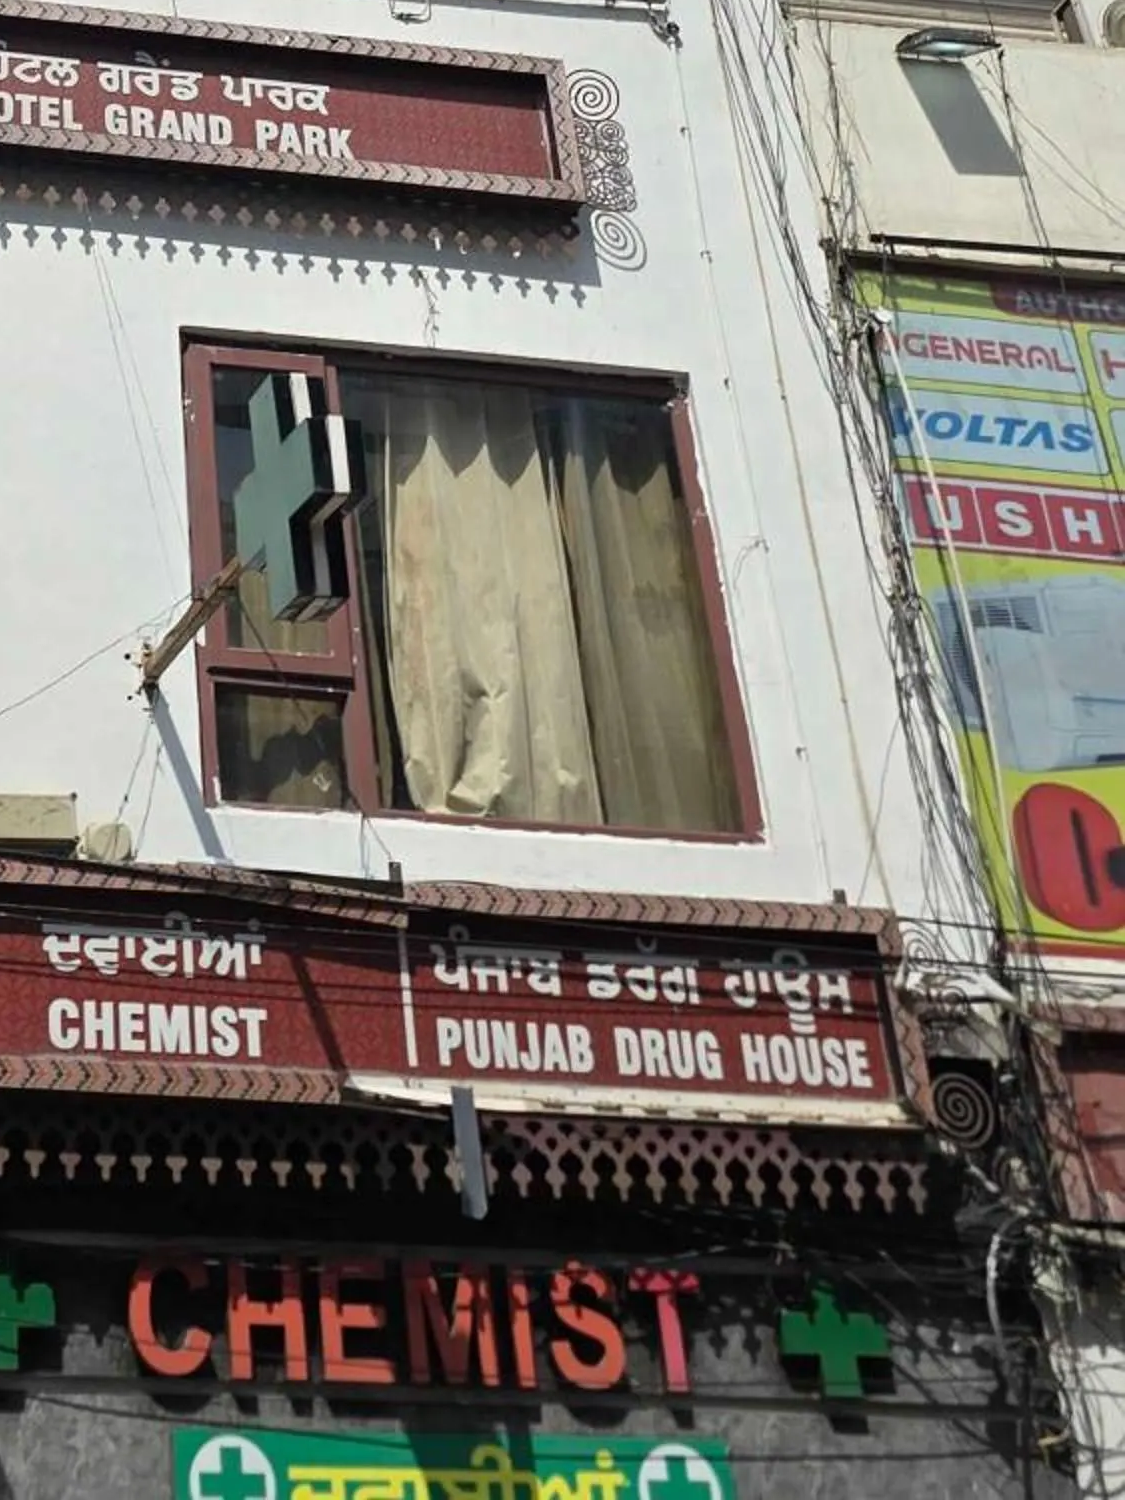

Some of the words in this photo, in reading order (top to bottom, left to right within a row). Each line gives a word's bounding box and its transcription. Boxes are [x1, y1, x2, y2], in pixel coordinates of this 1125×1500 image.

[97, 50, 203, 101] ਗਰੈਂਡ
[220, 74, 330, 115] ਪਾਰਕ
[104, 103, 233, 146] GRAND
[255, 120, 355, 160] PARK
[903, 331, 1076, 374] GENERAL
[892, 407, 1094, 453] VOLTAS
[42, 911, 266, 979] ਦਵਾਈਆਂ
[429, 924, 565, 997] ਪੰਜਾਬ
[47, 998, 268, 1058] CHEMIST
[436, 1016, 596, 1074] PUNJAB
[614, 1025, 724, 1081] DRUG
[740, 1032, 874, 1089] HOUSE
[127, 1254, 701, 1392] CHEMIST
